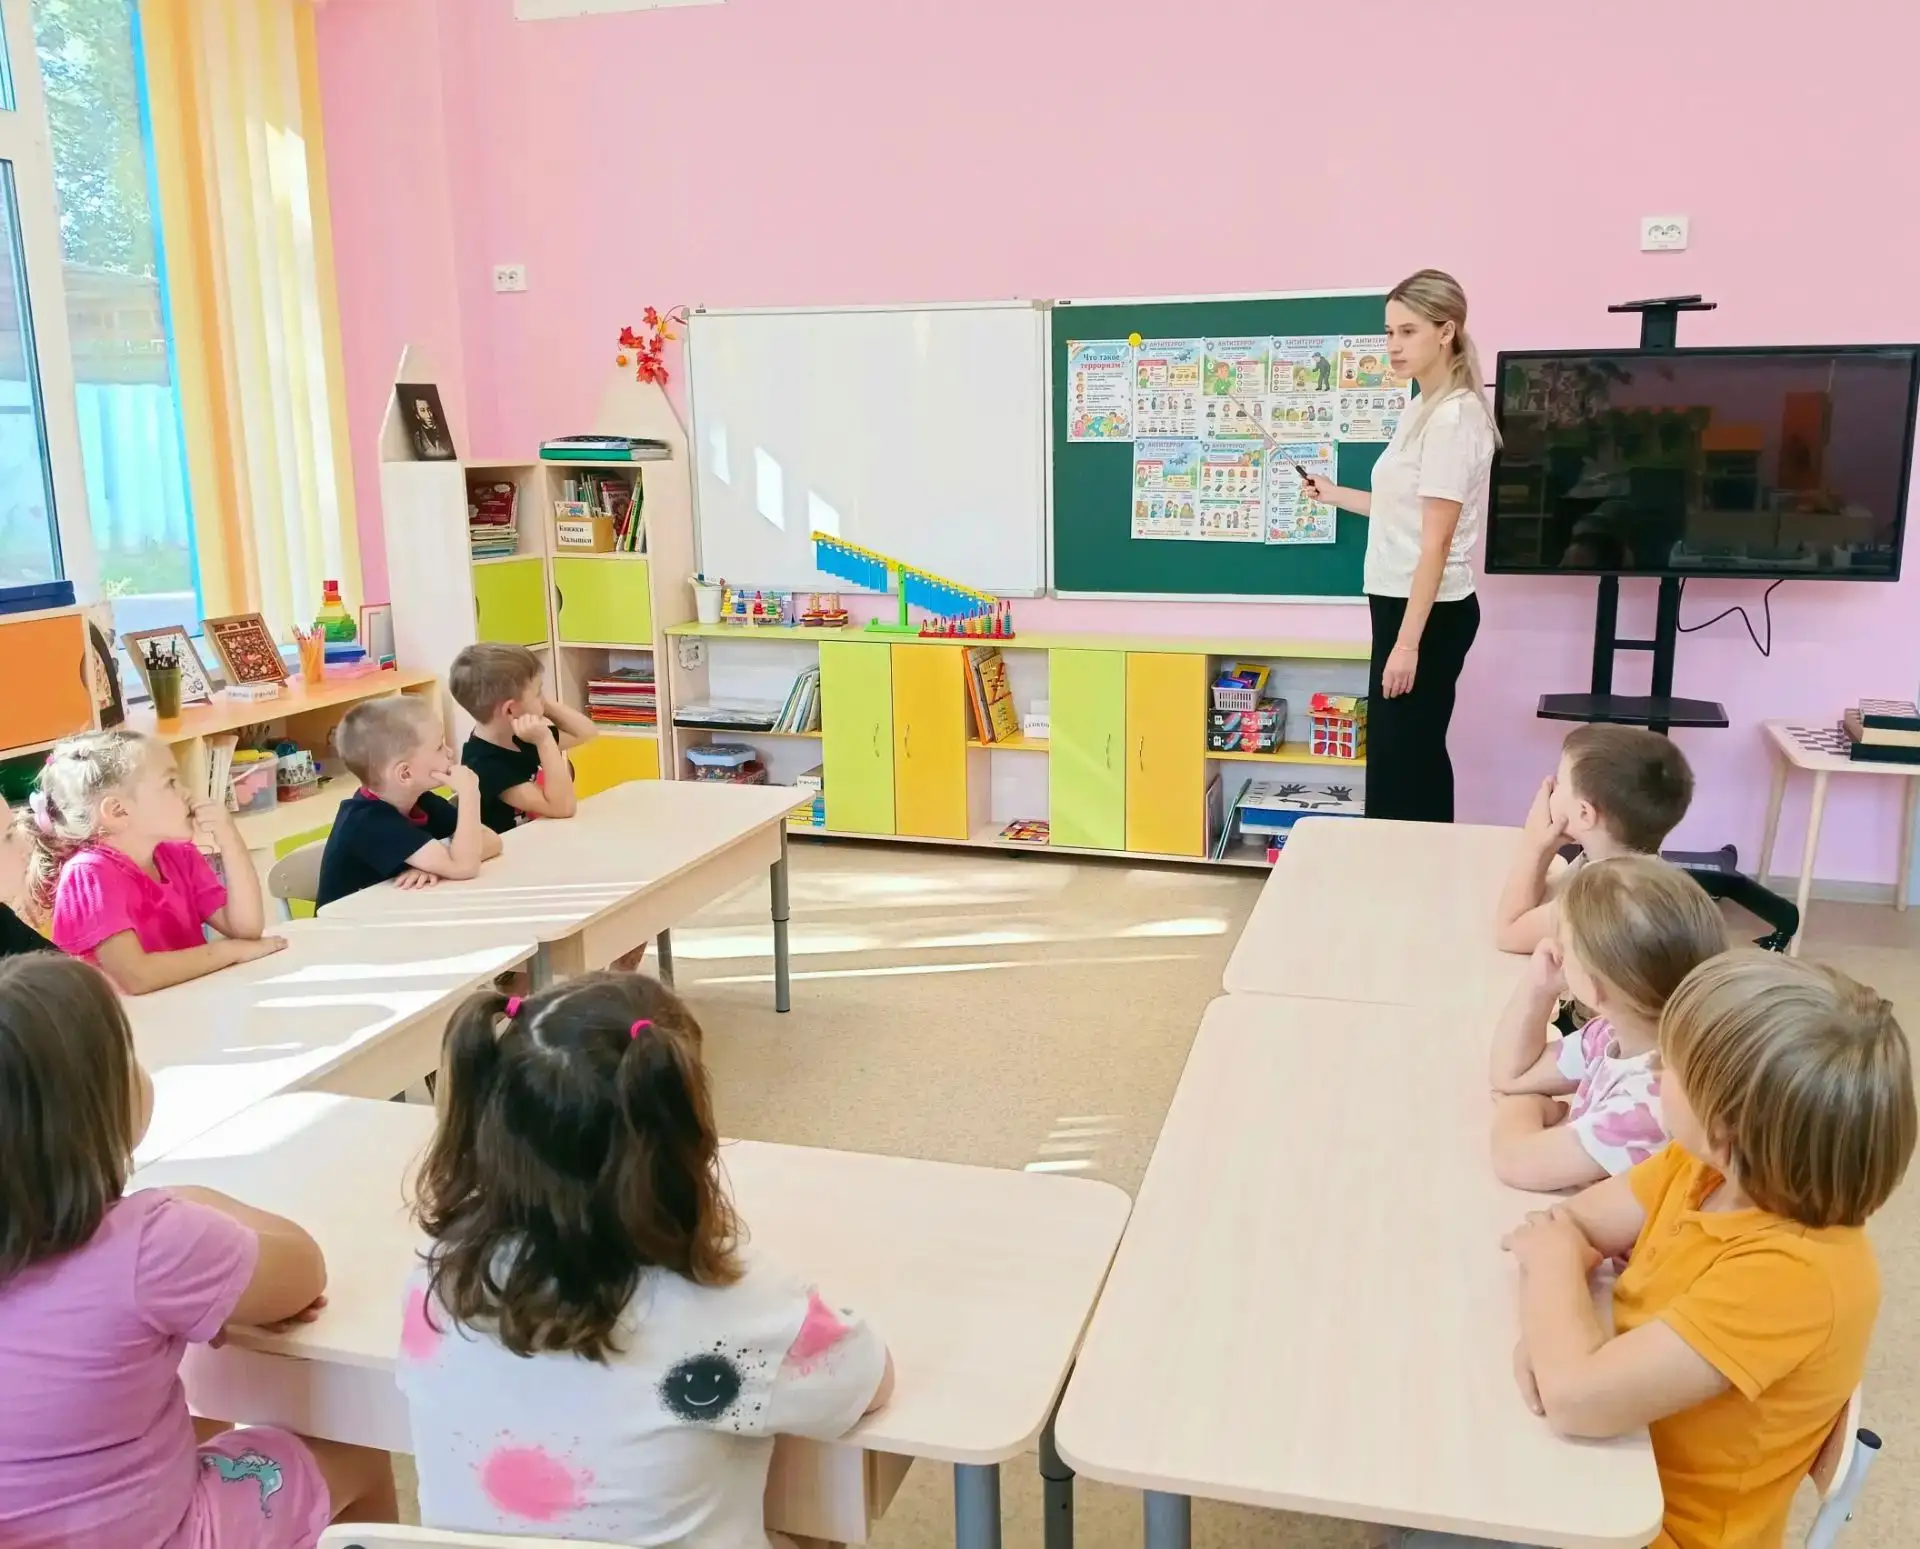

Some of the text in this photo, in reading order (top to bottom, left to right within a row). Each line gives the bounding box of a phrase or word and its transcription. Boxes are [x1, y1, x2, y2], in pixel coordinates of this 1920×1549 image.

[1081, 361, 1125, 370] терроризм?
[559, 525, 584, 533] Книжки
[560, 535, 592, 544] Малышки
